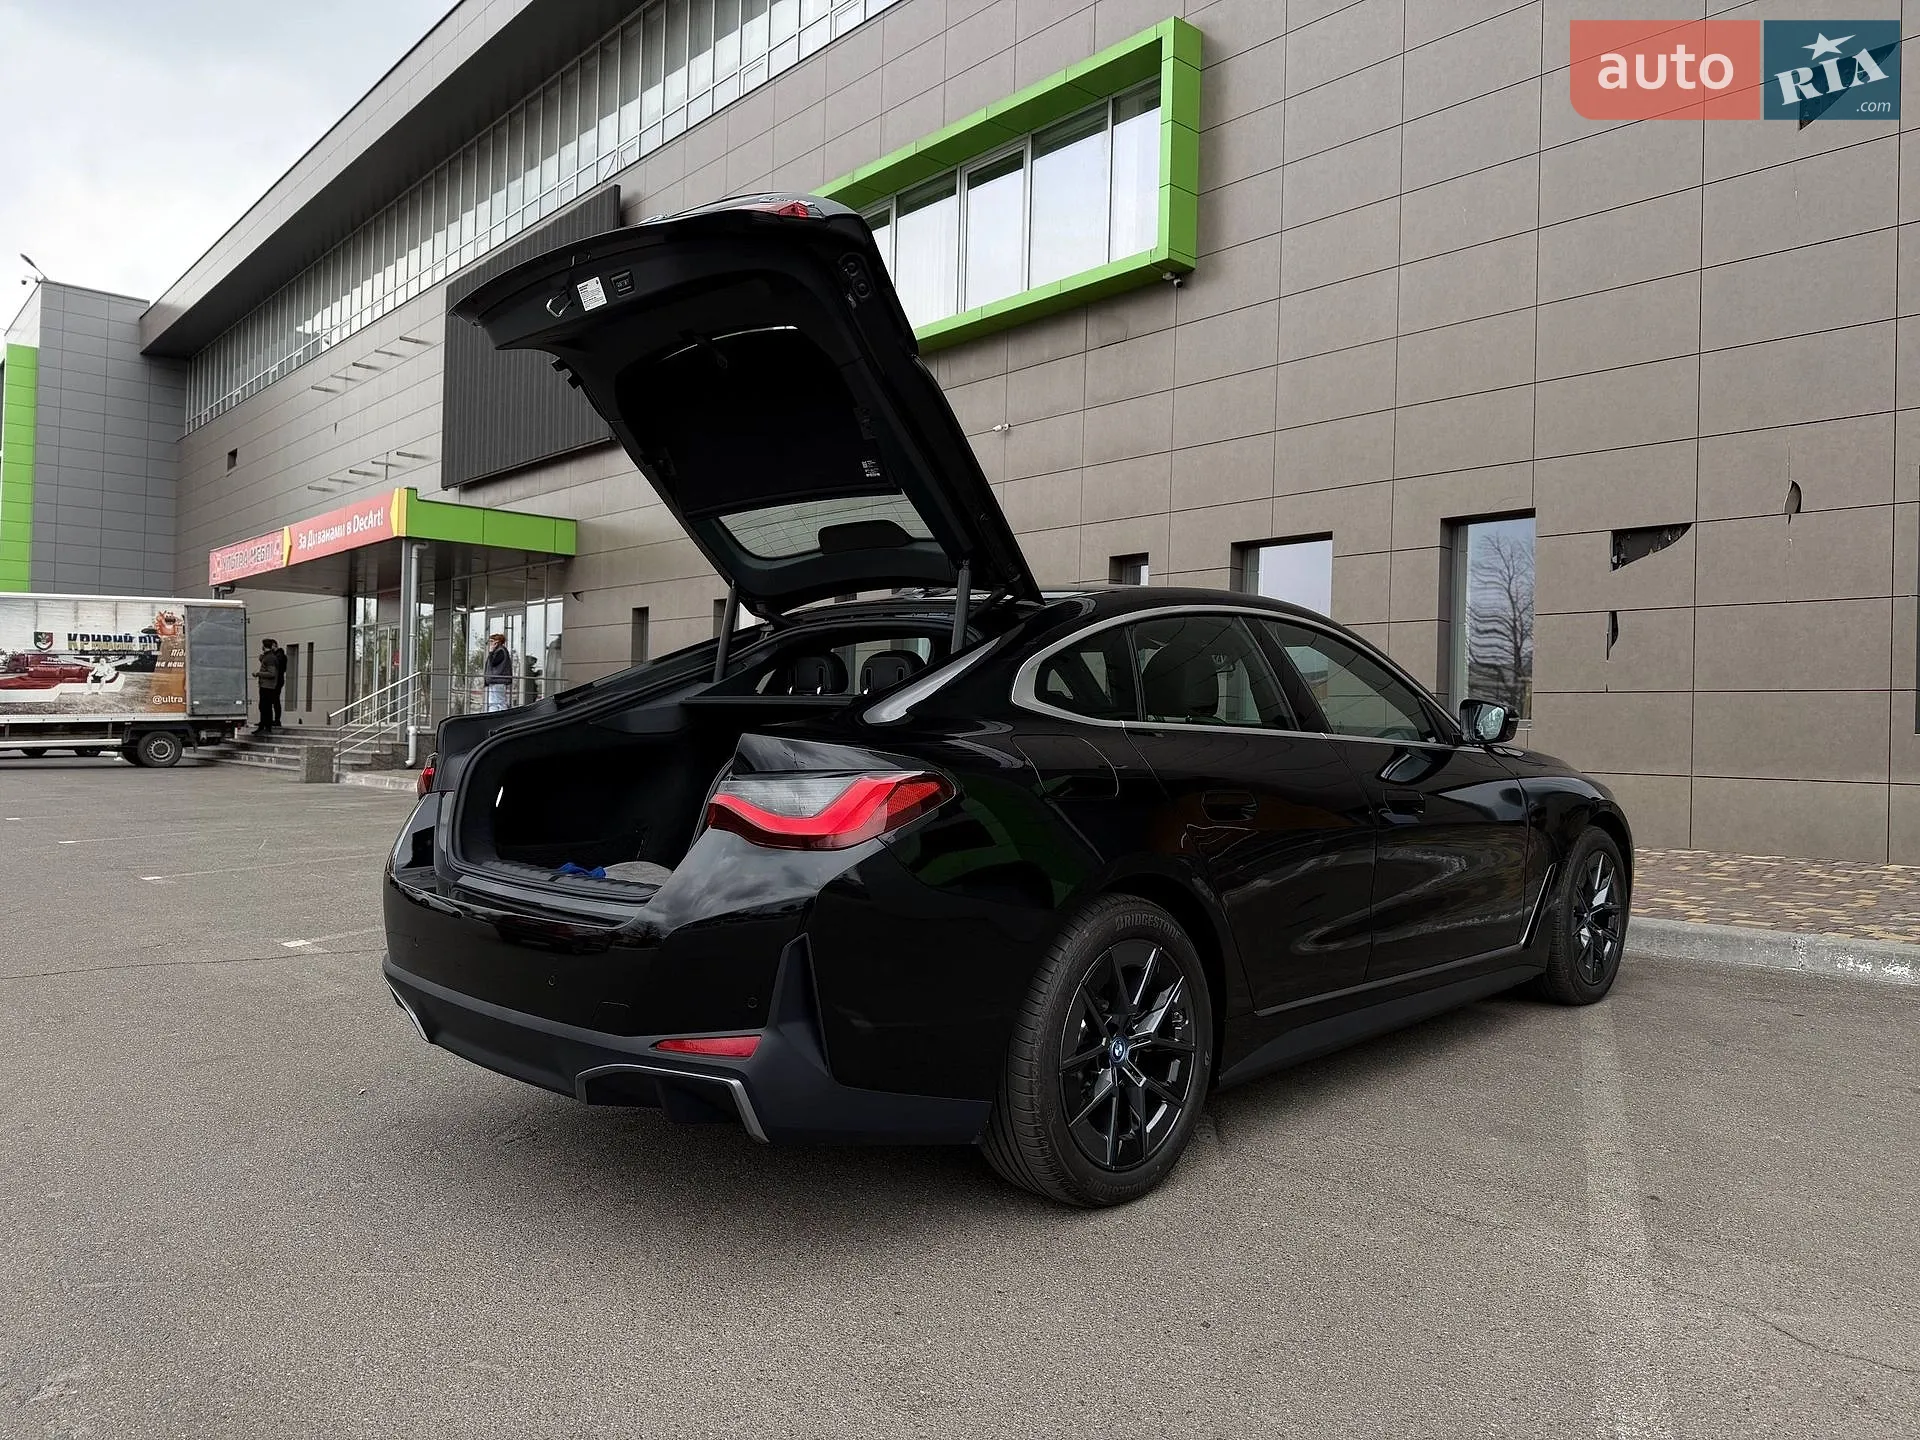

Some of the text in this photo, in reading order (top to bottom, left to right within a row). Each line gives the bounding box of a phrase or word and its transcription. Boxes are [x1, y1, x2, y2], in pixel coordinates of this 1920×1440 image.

[298, 506, 384, 550] За Диванами в DecArt!
[1115, 912, 1183, 941] BRIDGESTONE
